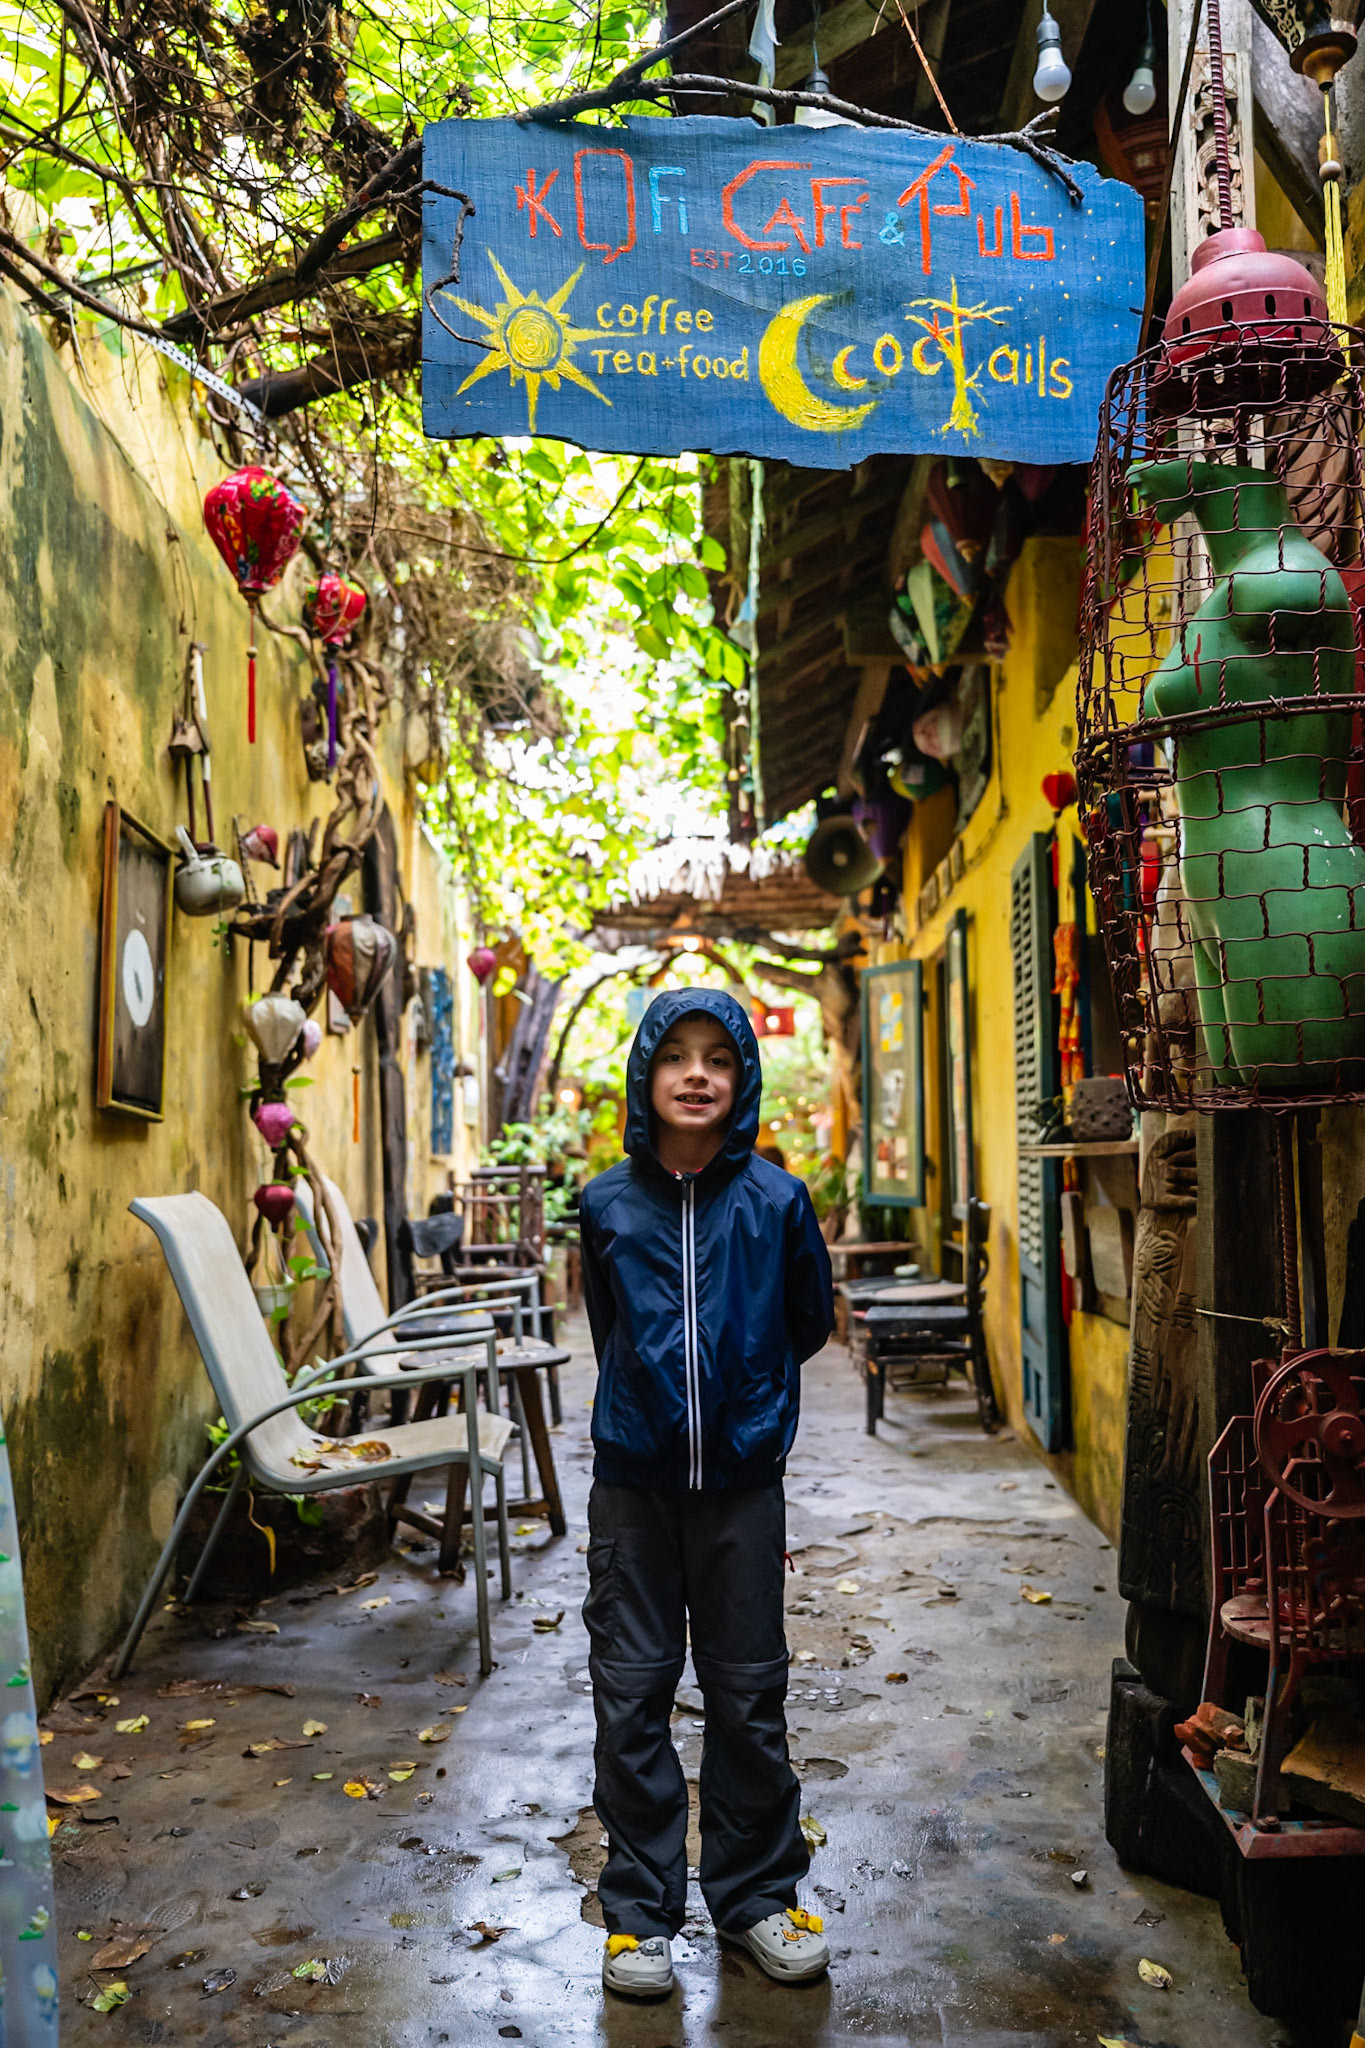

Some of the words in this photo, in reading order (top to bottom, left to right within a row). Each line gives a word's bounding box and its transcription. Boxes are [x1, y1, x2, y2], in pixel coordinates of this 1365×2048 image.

[879, 212, 905, 247] &
[690, 248, 734, 270] EST
[738, 254, 807, 277] 2016
[596, 294, 714, 335] coffee
